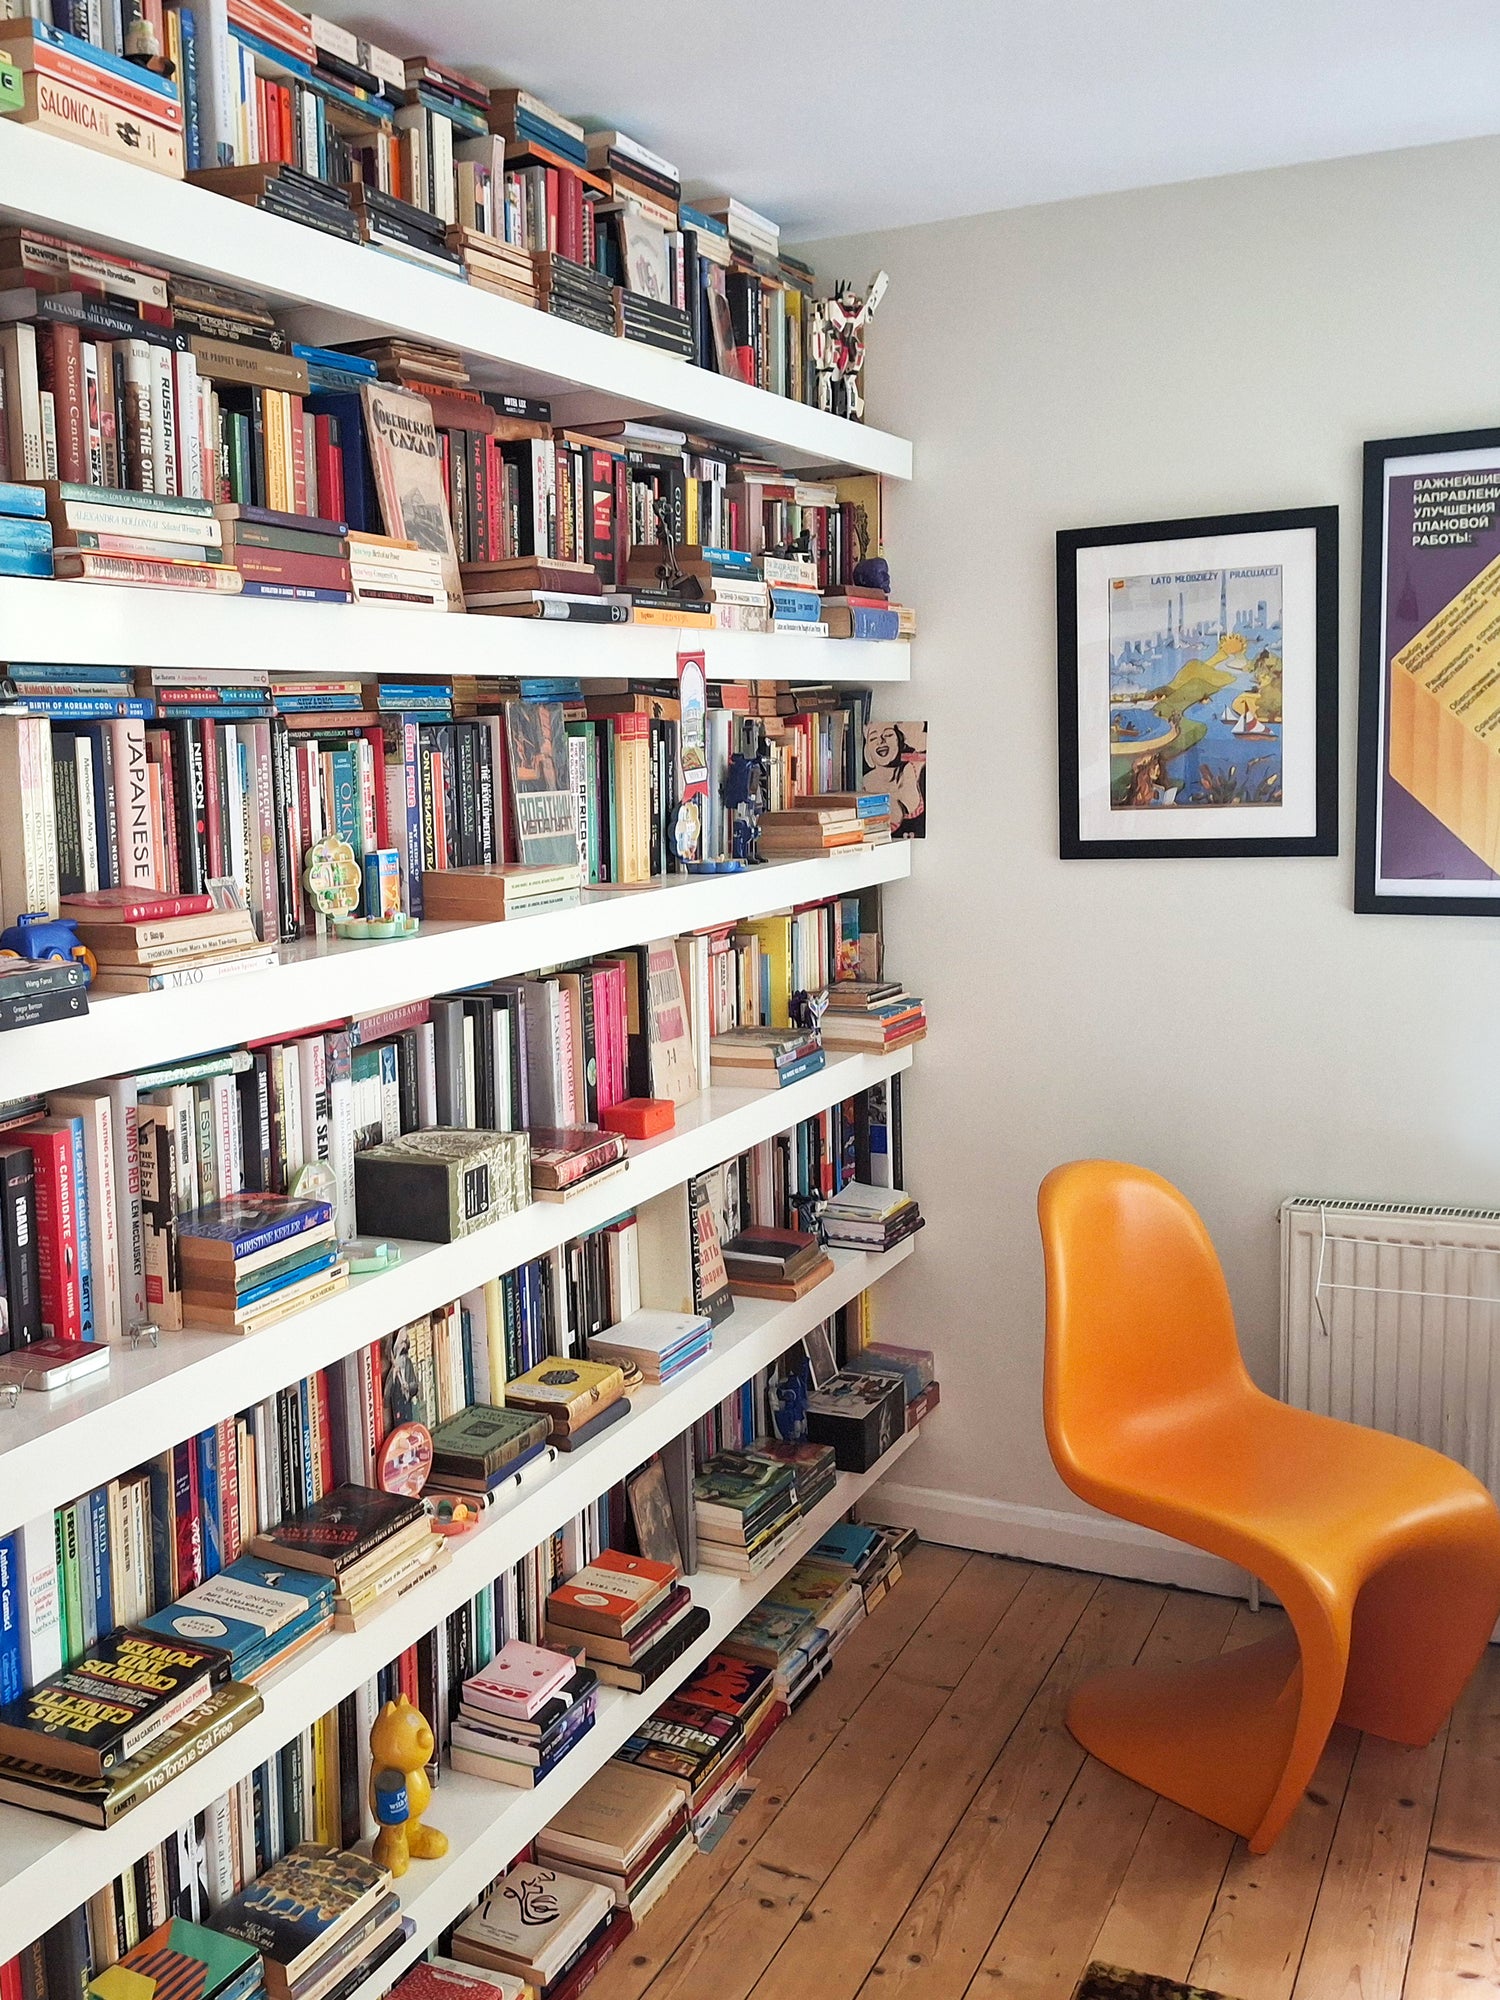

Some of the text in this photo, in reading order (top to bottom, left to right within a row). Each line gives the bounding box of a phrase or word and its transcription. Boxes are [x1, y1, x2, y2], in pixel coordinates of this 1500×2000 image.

[40, 86, 98, 131] SALONICA
[44, 300, 134, 333] ALEXANDER SHLYAPNIKOV
[211, 353, 258, 370] PROPHET OUTCAST
[67, 356, 81, 466] Soviet Century
[137, 384, 152, 453] FROM THE
[161, 378, 171, 451] RUSSIA IN
[455, 455, 463, 505] MAGNETIC
[1413, 472, 1500, 490] ВАЖНЕЙШИЕ
[1413, 502, 1495, 518] УЛУЧШЕНИЯ
[1413, 515, 1489, 532] ПЛАНОВОЙ
[1412, 532, 1472, 547] РАБОТЫ:
[92, 557, 211, 583] HAMBURG AT THE BARRICADES
[1150, 576, 1172, 585] LATO
[1229, 567, 1279, 579] PRACUJĄCEJ
[1399, 642, 1422, 665] Выбор
[1426, 643, 1474, 689] Рациональное
[1432, 654, 1474, 694] отраслевого
[1450, 668, 1495, 711] Обеспечение
[29, 702, 50, 710] BIRTH
[53, 702, 62, 710] OF
[64, 702, 91, 710] KOREAN
[94, 703, 112, 711] COOL
[194, 743, 205, 809] NIPPON
[405, 724, 416, 807] CHIN PENG
[464, 735, 473, 798] DRUMS OF
[127, 733, 150, 878] JAPANESE
[257, 769, 265, 814] DEFEAT
[261, 754, 270, 827] EMBRACING
[423, 751, 433, 849] ON THE SHADOW
[83, 758, 96, 869] Memories of May 1980
[109, 807, 117, 841] REAL
[241, 792, 249, 842] BUILDING
[413, 824, 418, 838] MY
[482, 783, 490, 850] DEVELOPMENTAL
[244, 845, 249, 853] A
[415, 867, 419, 882] OF
[172, 969, 204, 988] MAO
[363, 1003, 423, 1029] ERIC HOBSBAWM
[563, 992, 574, 1112] WILLIAM MORRIS
[258, 1071, 267, 1118] SHATTERED
[315, 1091, 327, 1119] THE
[101, 1111, 109, 1152] WAITING
[180, 1110, 189, 1165] BREAKTHROUGH
[200, 1110, 212, 1183] ESTATES
[261, 1119, 269, 1150] NATION
[76, 1152, 84, 1183] PARTY
[125, 1107, 139, 1218] ALWAYS RED LEN
[60, 1165, 71, 1238] CANDIDATE
[78, 1187, 85, 1197] IS
[16, 1196, 28, 1247] FRAUD
[79, 1199, 87, 1239] ALWAYS
[236, 1229, 273, 1257] CHRISTINE
[82, 1275, 91, 1313] BEATTY
[305, 1460, 311, 1473] IN
[313, 1452, 319, 1465] MY
[229, 1476, 238, 1498] OF
[67, 1512, 76, 1559] FREUD
[98, 1506, 107, 1553] FREUD
[0, 1549, 12, 1631] Antonio Gramsci
[116, 1640, 203, 1667] POWER
[118, 1656, 171, 1673] AND
[78, 1660, 177, 1690] CROWDS
[27, 1704, 102, 1732] ELIAS
[28, 1690, 134, 1724] CANETTI
[126, 1735, 140, 1749] ELIAS
[140, 1720, 161, 1740] CANETTI
[641, 1720, 720, 1746] SHELTER
[643, 1730, 689, 1747] TIME
[145, 1721, 233, 1793] The Tongue Set Free
[113, 1794, 136, 1815] CANETTI
[216, 1808, 227, 1885] Music at the
